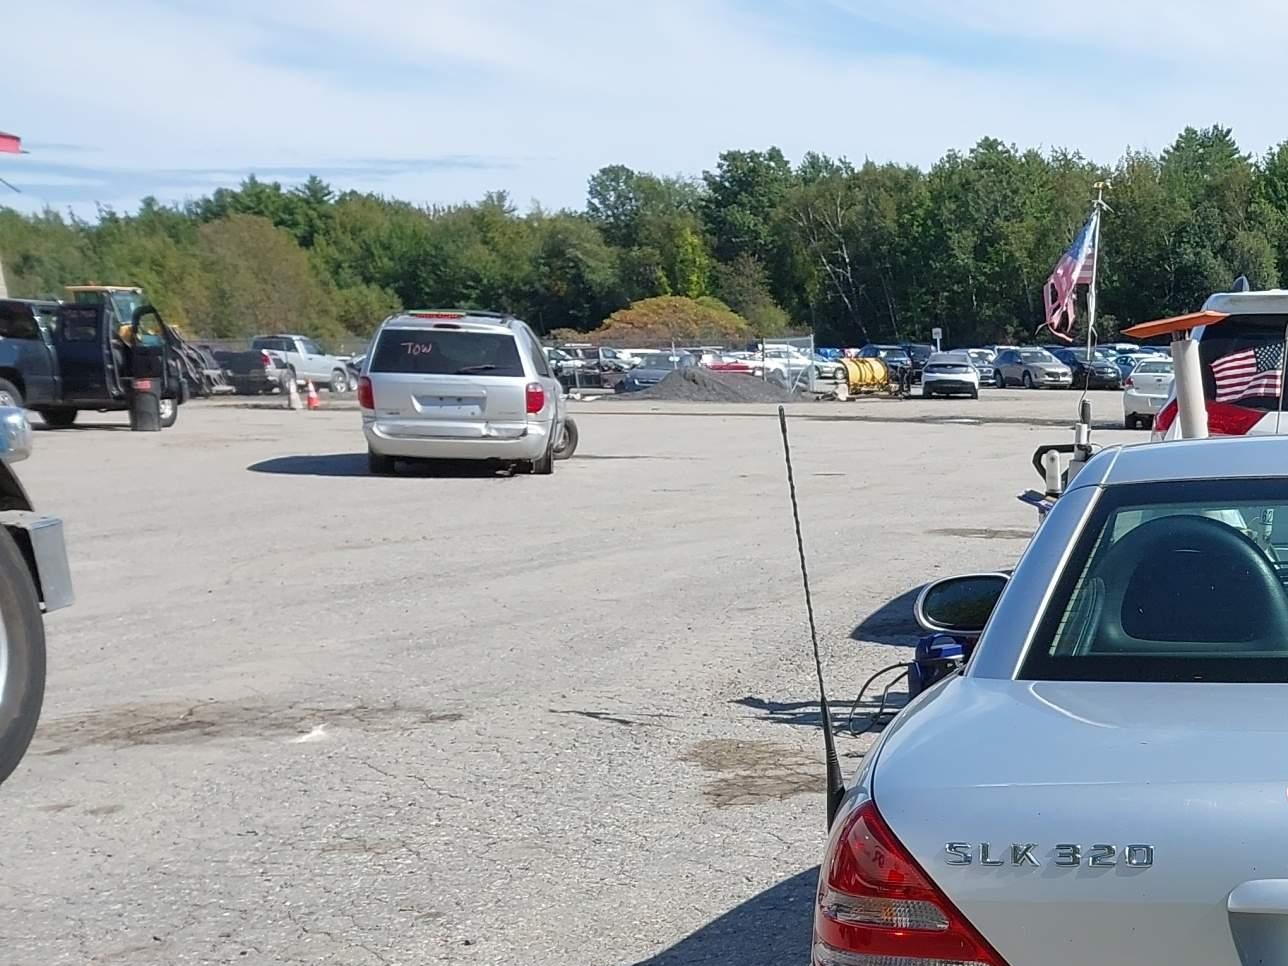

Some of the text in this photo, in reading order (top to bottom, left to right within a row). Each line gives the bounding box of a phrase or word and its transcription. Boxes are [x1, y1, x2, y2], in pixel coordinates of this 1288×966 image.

[400, 341, 433, 356] TOW
[945, 841, 1154, 868] SLK 320
